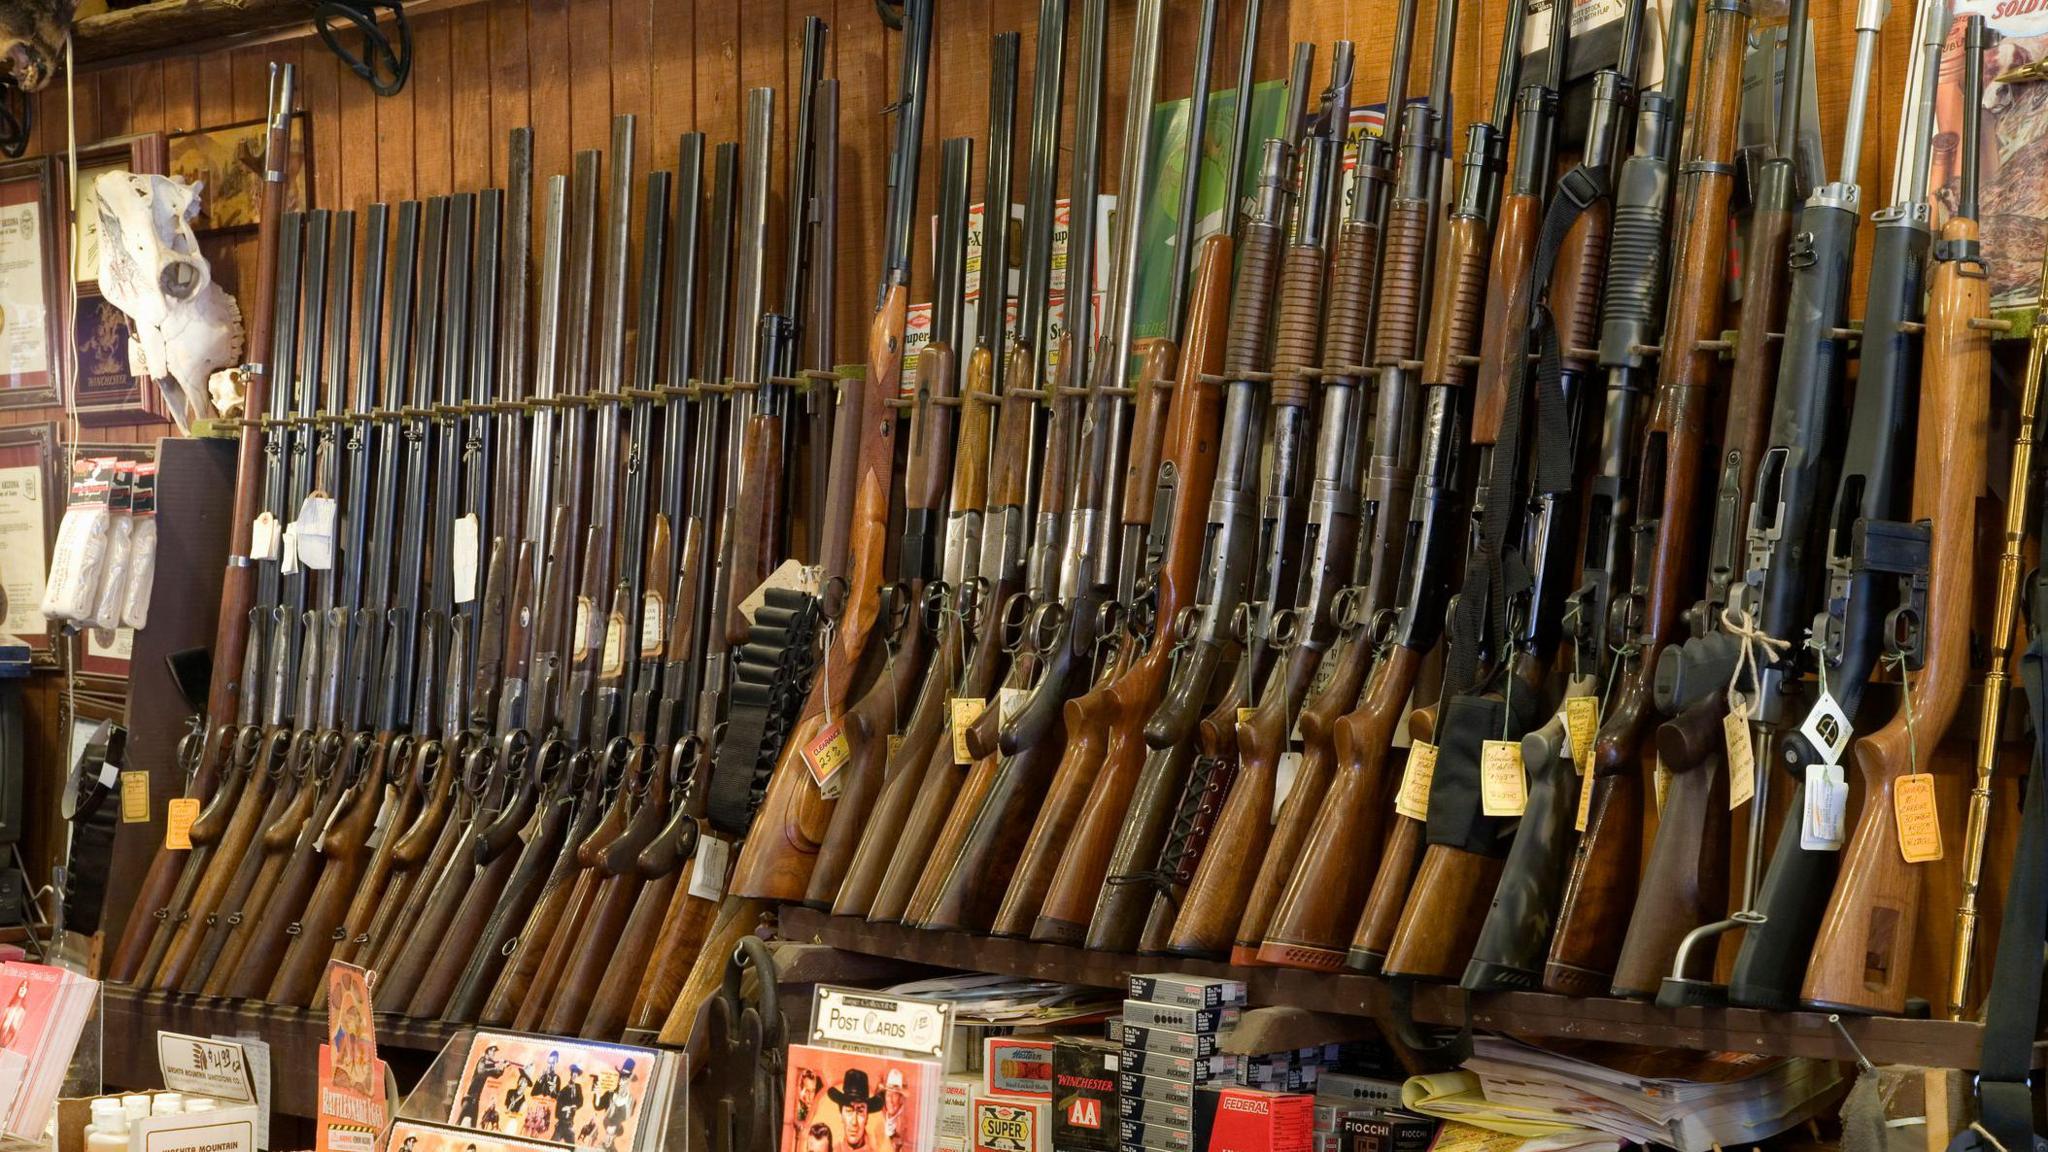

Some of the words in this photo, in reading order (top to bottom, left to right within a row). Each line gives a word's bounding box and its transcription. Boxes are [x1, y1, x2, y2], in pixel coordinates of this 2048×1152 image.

[1991, 0, 2038, 19] SOLD
[906, 332, 930, 346] uper-
[1058, 1074, 1114, 1092] WINCHESTER
[1070, 1099, 1098, 1126] AA
[1223, 1097, 1268, 1114] FEDERAL
[987, 1120, 1022, 1138] SUPER
[1345, 1122, 1389, 1136] FIOCCHI
[1401, 1129, 1427, 1139] FIOCCHI
